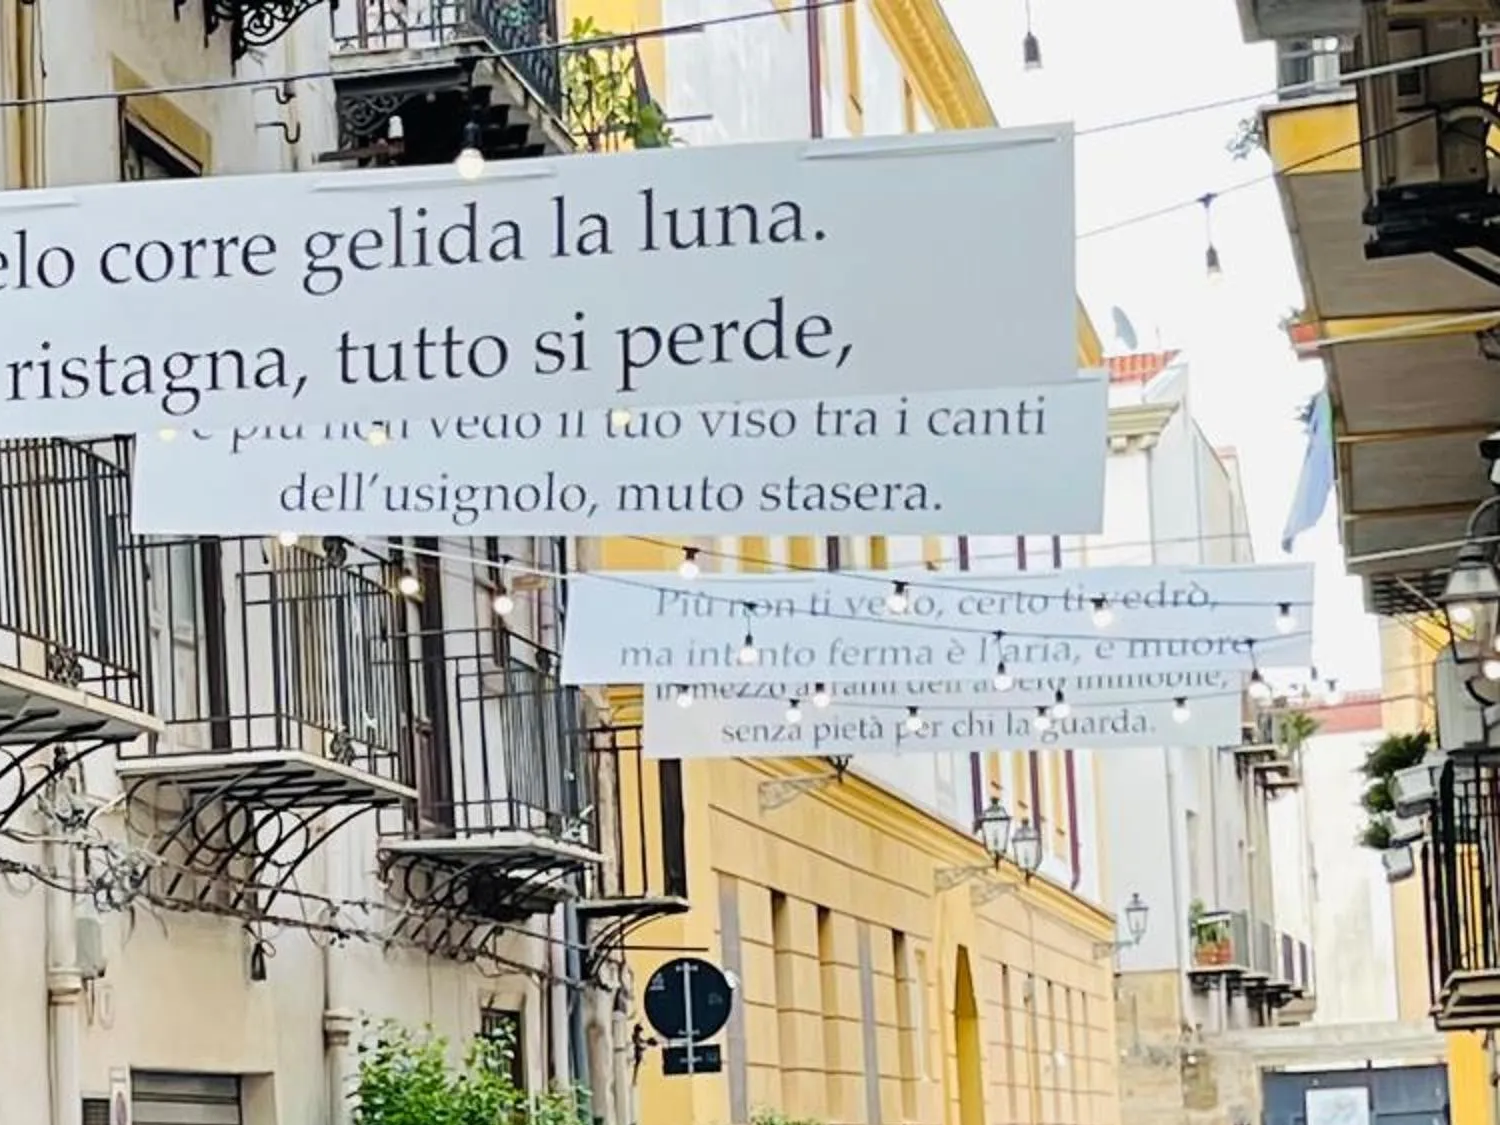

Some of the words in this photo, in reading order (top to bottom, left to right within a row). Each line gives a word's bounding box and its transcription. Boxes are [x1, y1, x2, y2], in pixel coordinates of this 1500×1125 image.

[99, 231, 279, 285] corre
[301, 201, 526, 297] gelida
[549, 195, 613, 258] la
[638, 186, 827, 253] luna.
[6, 341, 308, 416] ristagna,
[336, 325, 509, 385] tutto
[534, 311, 592, 375] si
[615, 296, 854, 394] perde,
[700, 400, 797, 440] viso
[815, 400, 879, 437] tra
[895, 396, 911, 437] i
[926, 396, 1048, 437] canti
[616, 476, 744, 513] muto
[758, 475, 943, 513] stasera.
[656, 587, 715, 618] Più
[727, 598, 795, 619] non
[810, 590, 839, 617] ti
[957, 591, 1049, 618] certo
[1062, 582, 1084, 613] ti
[619, 646, 673, 668] ma
[686, 639, 817, 669] intnto
[828, 637, 934, 668] ferma
[946, 637, 966, 664] è
[1094, 643, 1114, 660] e
[1126, 637, 1254, 660] muore
[721, 723, 802, 744] senza
[813, 718, 884, 748] pietà
[951, 710, 994, 738] chi
[1006, 710, 1030, 738] la
